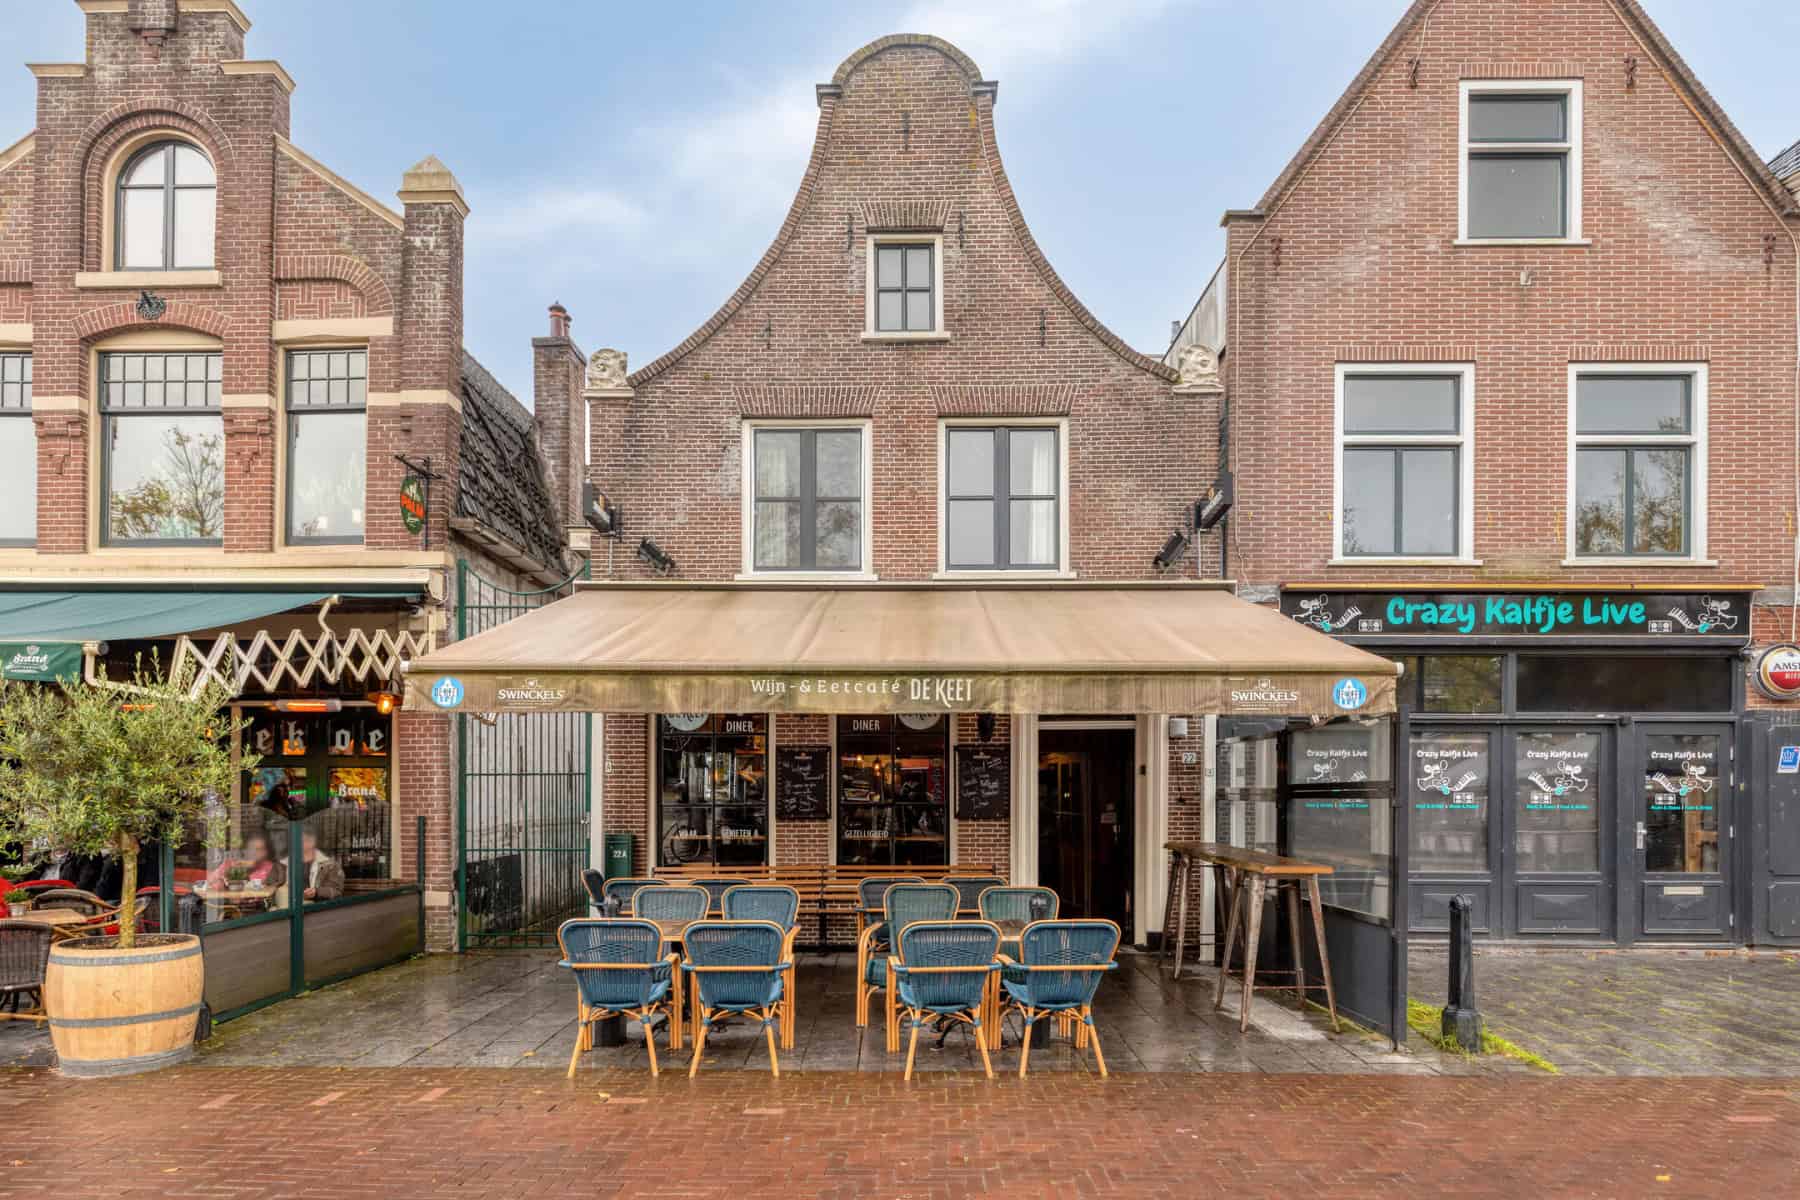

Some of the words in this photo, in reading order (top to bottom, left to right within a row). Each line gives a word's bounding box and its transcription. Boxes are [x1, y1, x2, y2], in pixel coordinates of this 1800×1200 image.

[1386, 595, 1476, 633] Crazy
[1484, 595, 1575, 633] Kalfje
[1583, 597, 1647, 625] Live
[817, 678, 901, 694] Eetcafé
[910, 678, 931, 701] DE
[935, 678, 973, 708] KEET
[726, 720, 754, 733] DINER
[852, 719, 881, 732] DINER
[1183, 753, 1194, 763] 22
